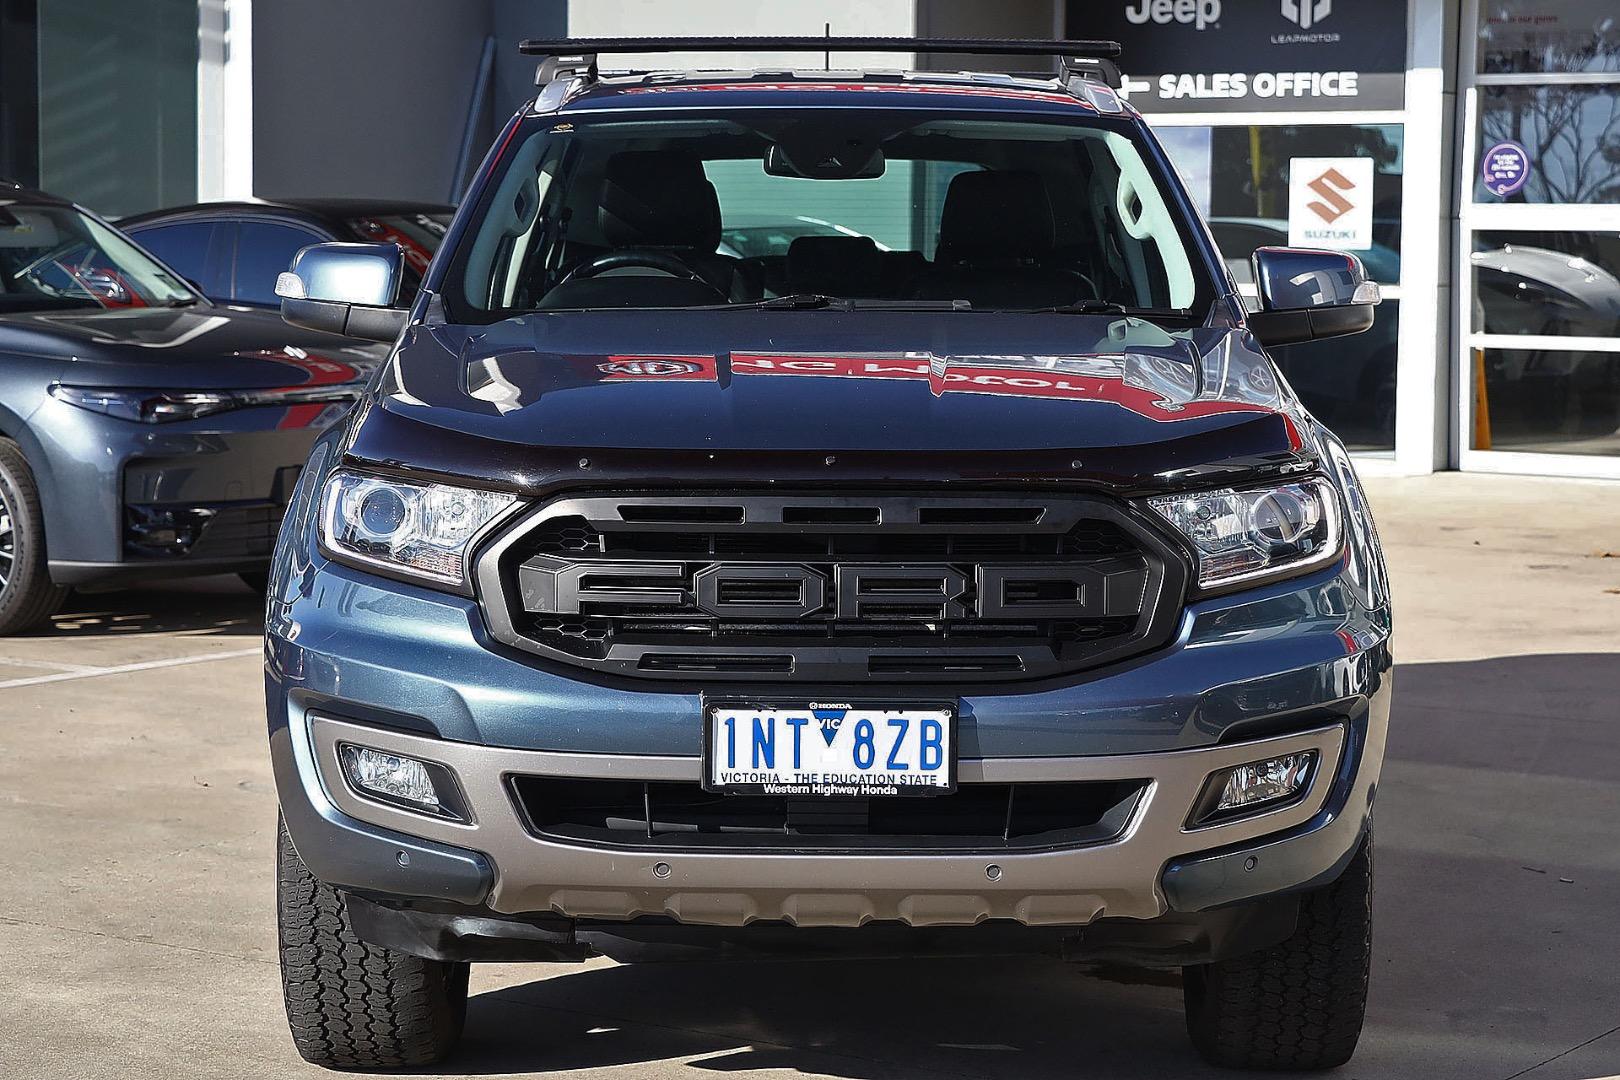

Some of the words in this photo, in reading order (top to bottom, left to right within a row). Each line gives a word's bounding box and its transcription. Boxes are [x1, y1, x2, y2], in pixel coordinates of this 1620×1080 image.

[1125, 0, 1221, 30] Jeep
[1271, 34, 1340, 43] LEAPMOTOR
[1158, 73, 1248, 98] SALES
[1252, 71, 1359, 98] OFFICE
[1304, 230, 1357, 239] SUZUKI
[519, 553, 1150, 618] FORD
[816, 718, 841, 730] VIC
[724, 717, 808, 769] 1NT
[853, 718, 943, 770] 8ZB
[721, 772, 780, 784] VICTORIA
[794, 773, 818, 784] THE
[822, 773, 895, 785] EDUCATION
[900, 774, 937, 785] STATE
[763, 784, 809, 795] Western
[812, 784, 859, 796] Highway
[860, 785, 898, 795] Honda
